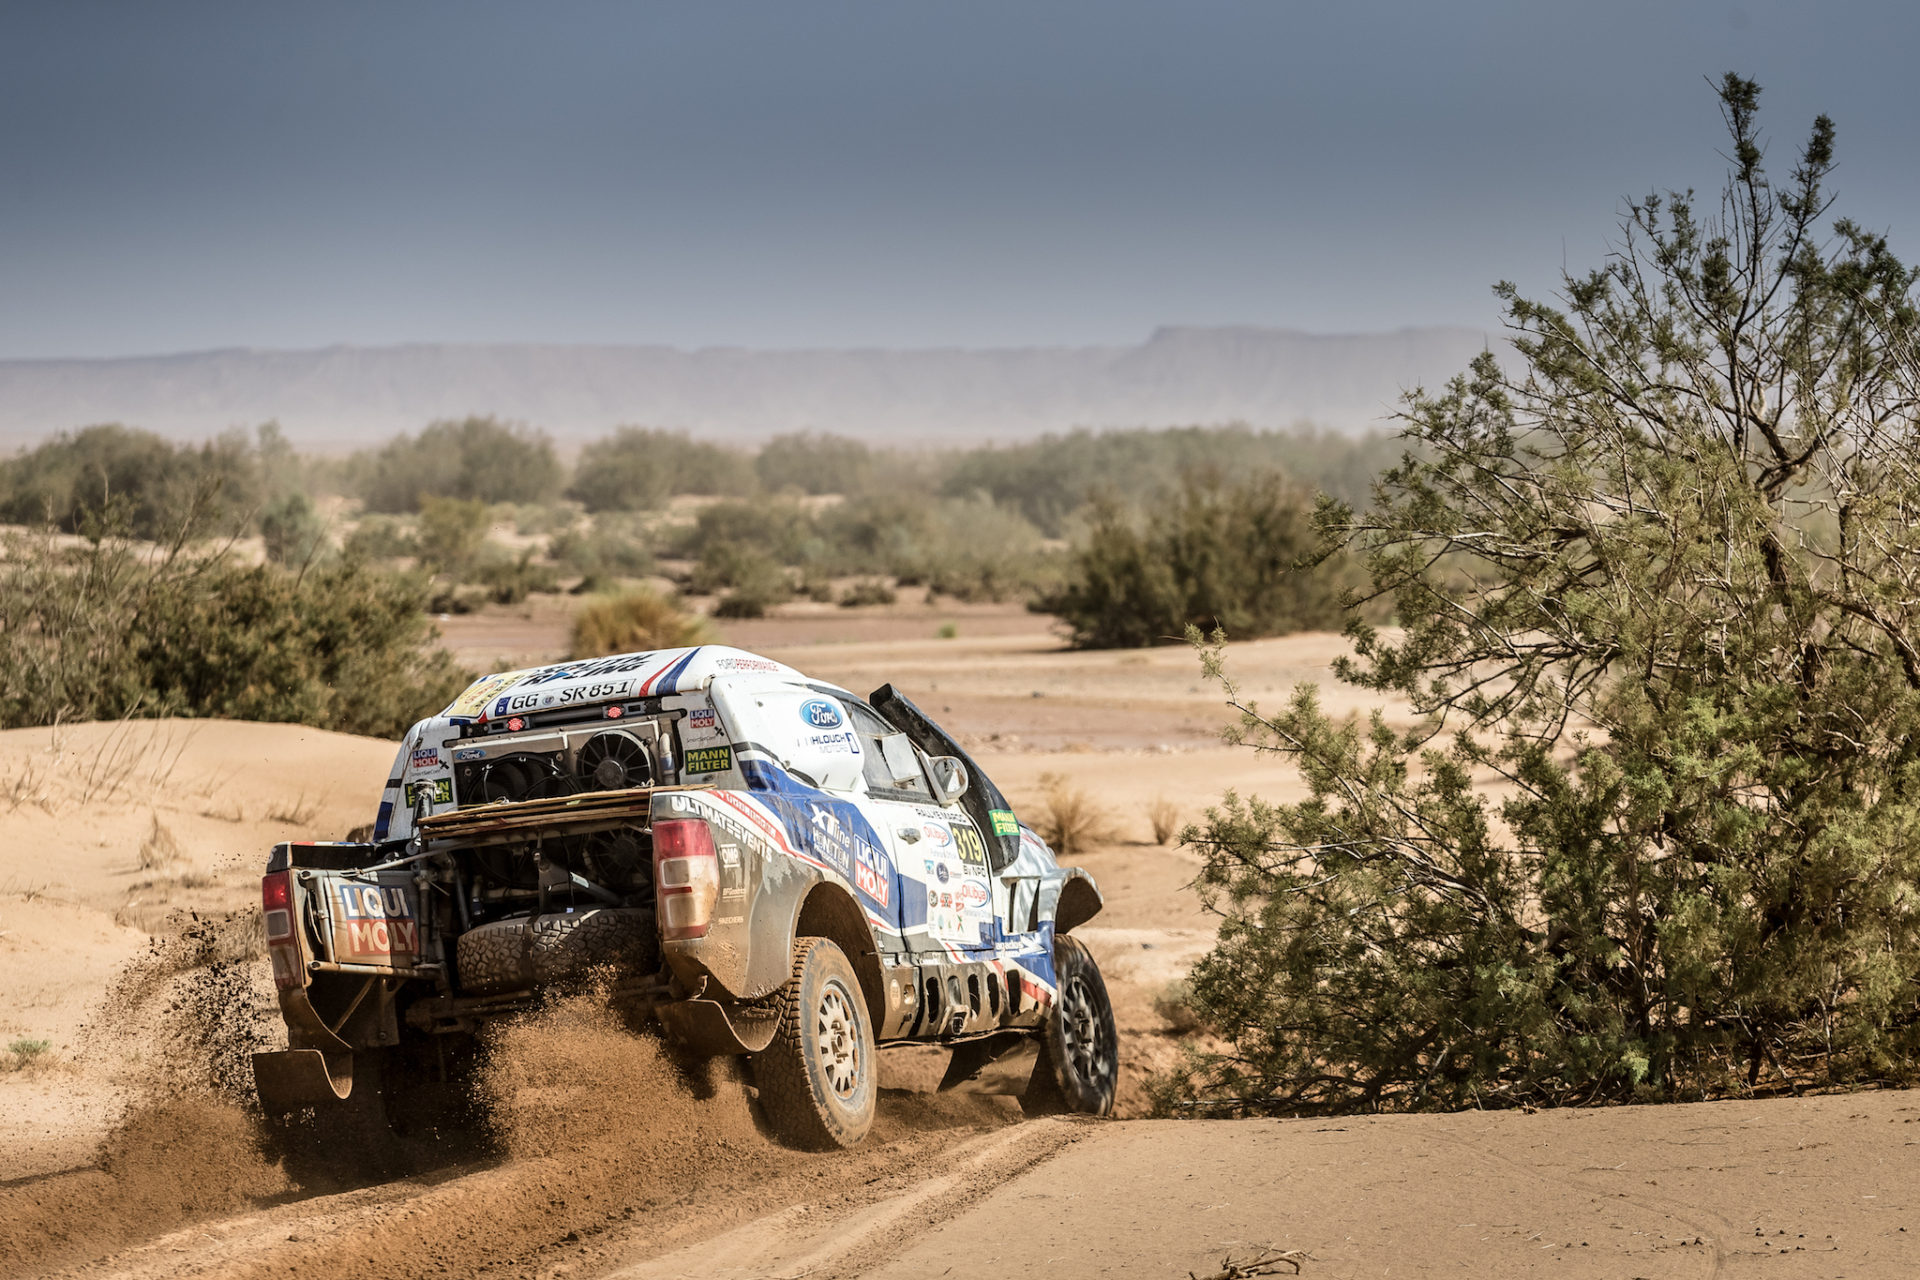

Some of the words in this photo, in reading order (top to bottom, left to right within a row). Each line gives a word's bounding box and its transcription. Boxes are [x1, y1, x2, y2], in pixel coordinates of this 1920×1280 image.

[511, 693, 539, 710] GG
[560, 687, 588, 703] SR
[589, 682, 628, 698] 851
[690, 708, 714, 719] LIQUI
[690, 718, 715, 728] MOLY
[810, 702, 838, 725] Ford
[413, 748, 438, 759] LIQUI
[413, 758, 438, 768] MOLY
[461, 750, 481, 760] Ford
[687, 747, 729, 762] MANN
[688, 758, 729, 772] FILTER
[952, 827, 983, 862] 319
[855, 838, 887, 879] LIQUI
[857, 863, 888, 907] MOLY
[342, 887, 409, 918] LIQUI
[351, 921, 414, 952] MOLY
